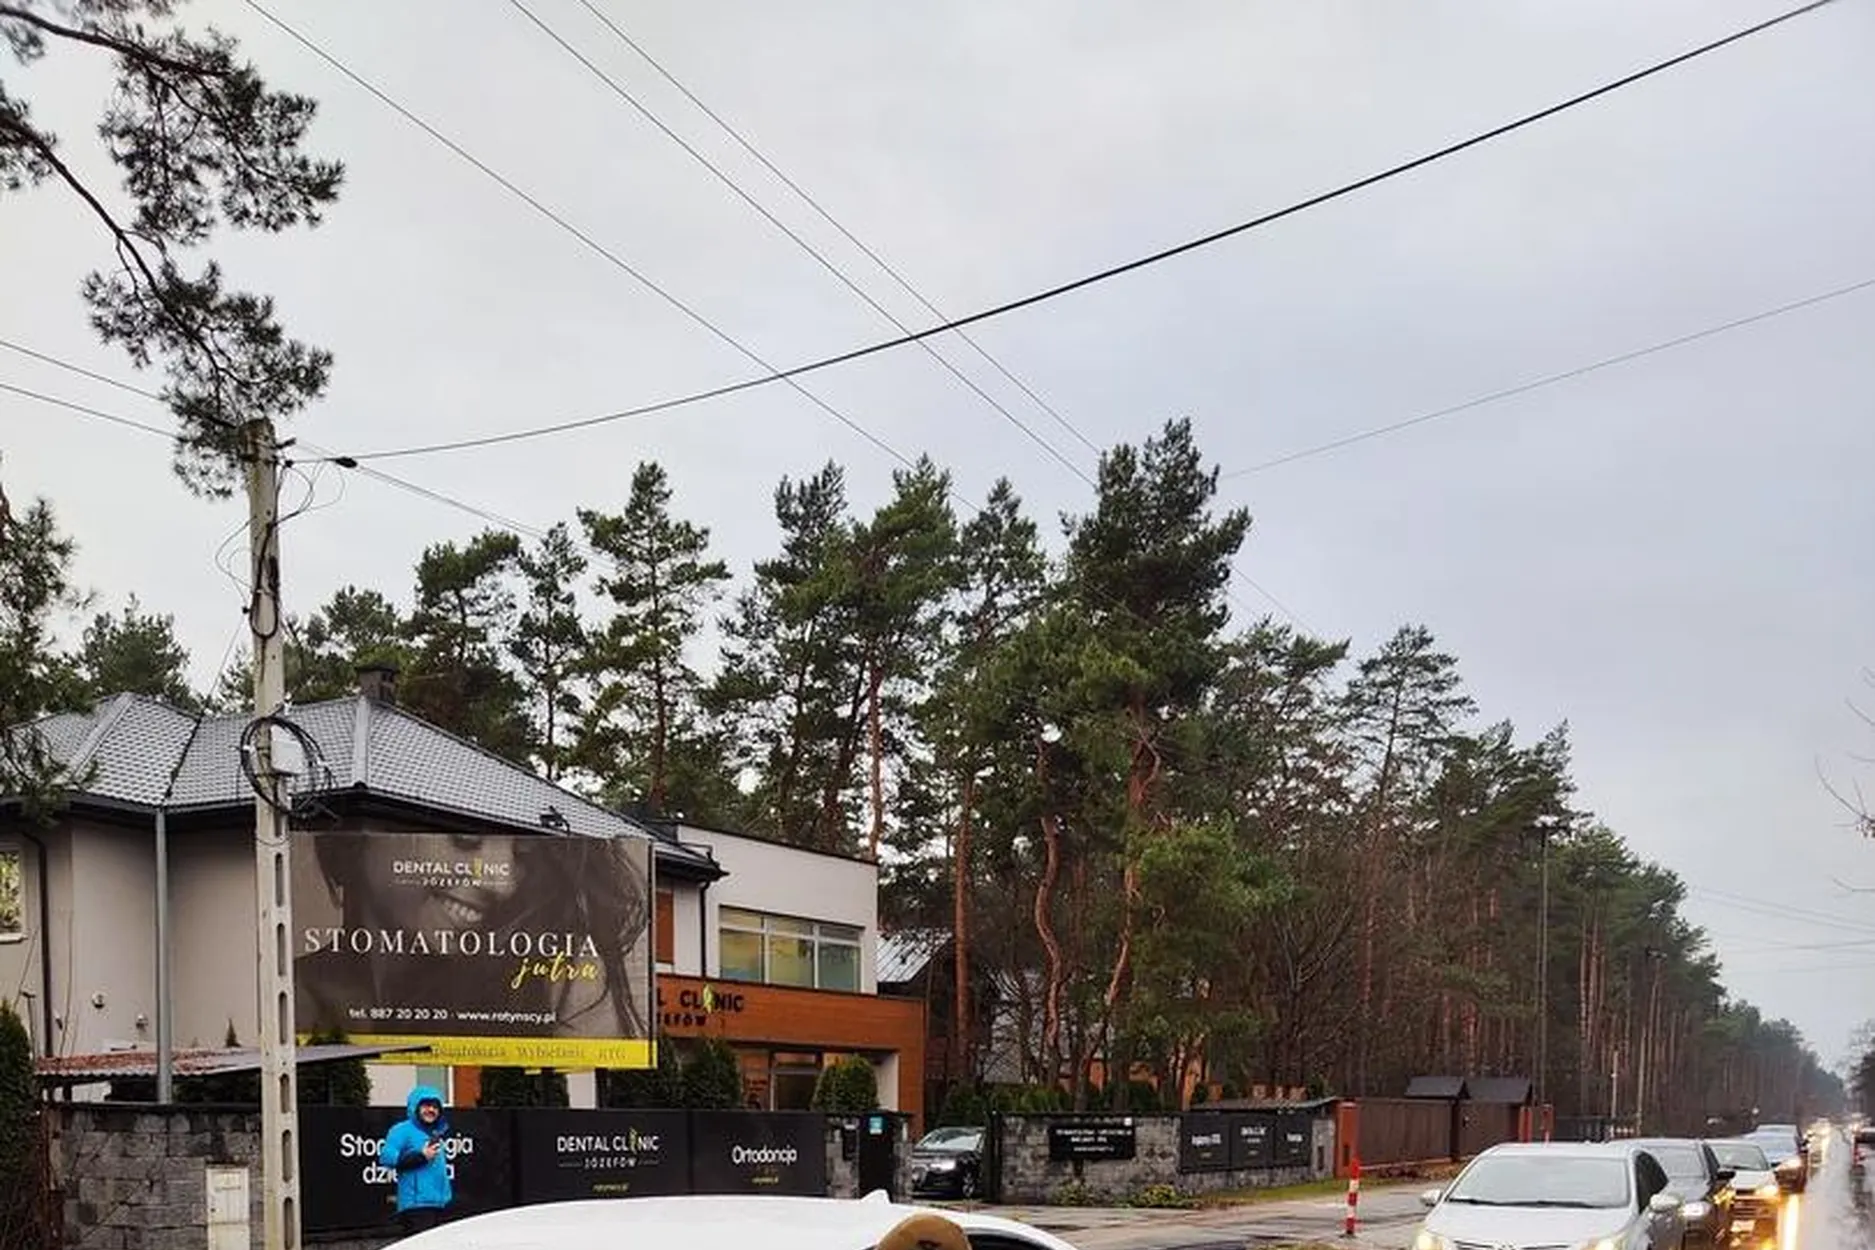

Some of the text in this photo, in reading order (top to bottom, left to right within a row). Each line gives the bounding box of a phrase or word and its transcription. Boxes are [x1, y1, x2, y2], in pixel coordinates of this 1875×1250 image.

[392, 860, 452, 875] DENTAL
[303, 927, 601, 959] STOMATOLOGIA
[510, 950, 600, 990] jutra
[349, 1007, 367, 1020] tel.
[396, 1008, 413, 1020] 20
[414, 1008, 431, 1020] 20
[432, 1008, 448, 1020] 20
[556, 1135, 610, 1152] DENTAL
[731, 1144, 798, 1166] Ortodoncja
